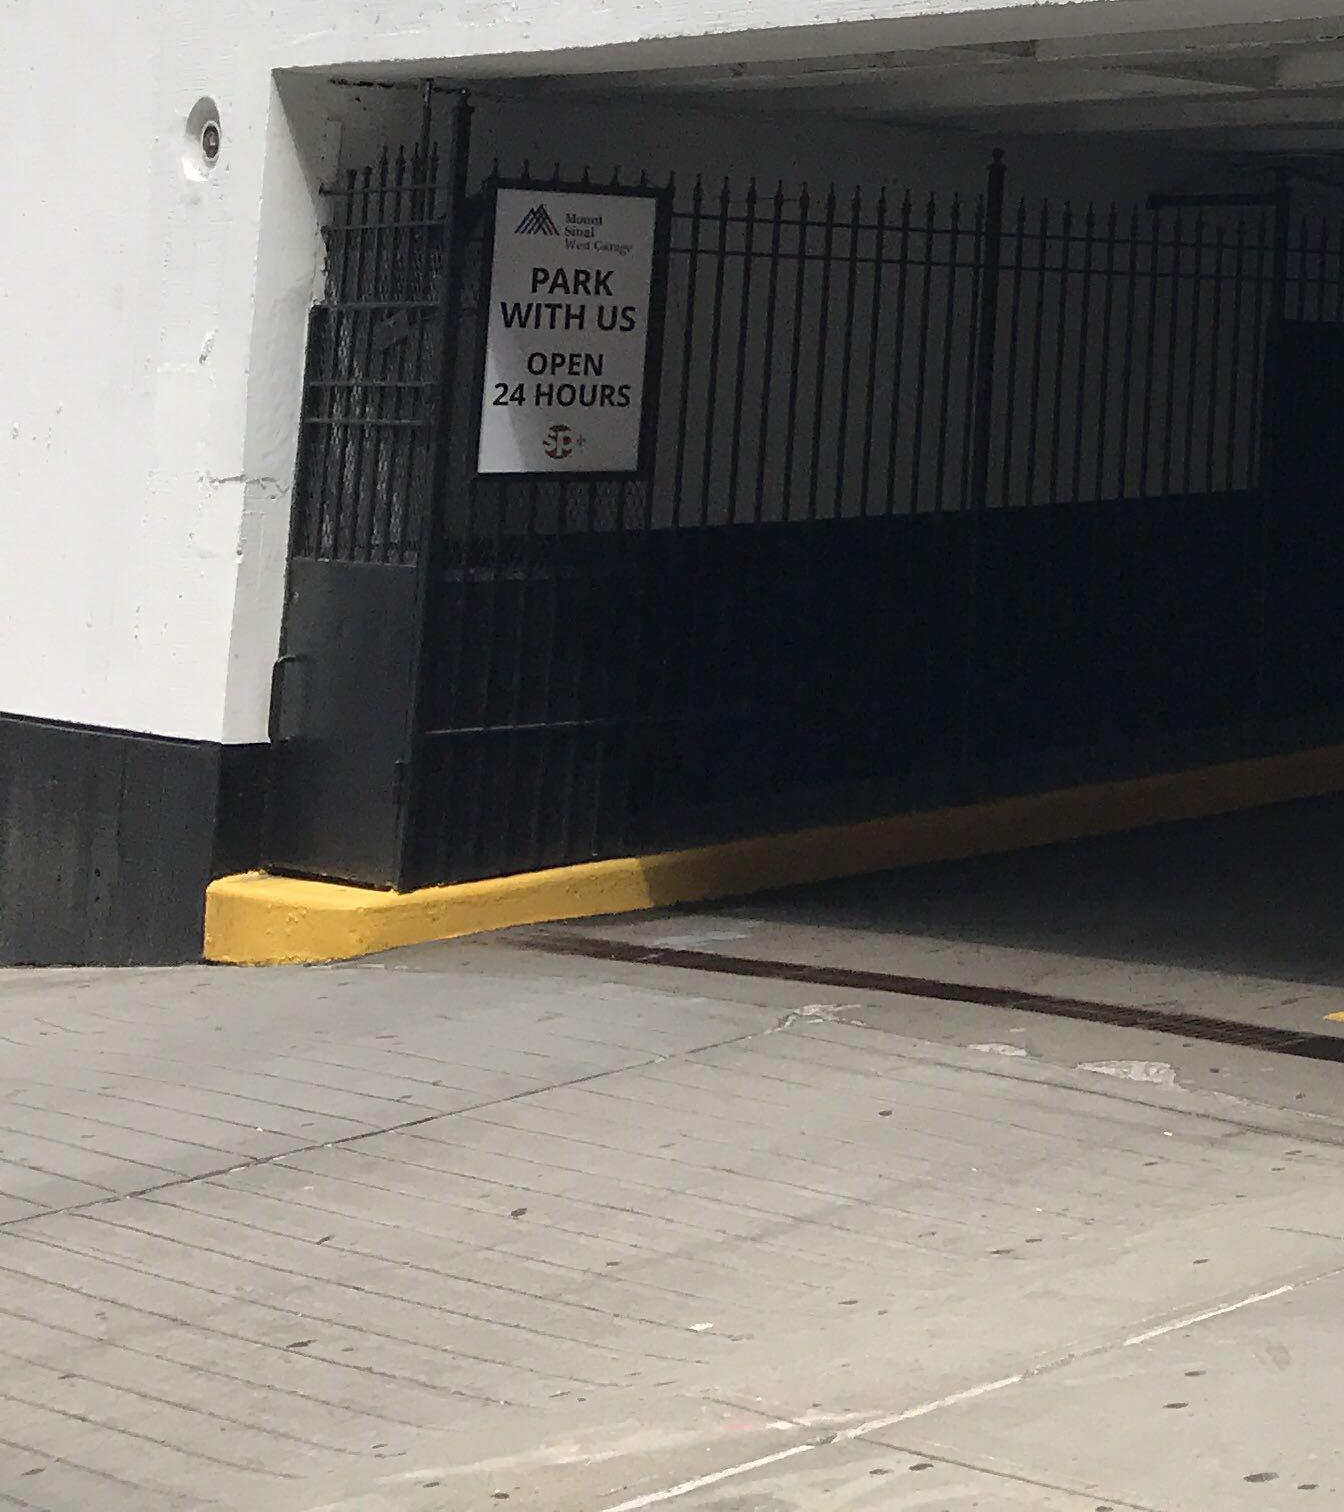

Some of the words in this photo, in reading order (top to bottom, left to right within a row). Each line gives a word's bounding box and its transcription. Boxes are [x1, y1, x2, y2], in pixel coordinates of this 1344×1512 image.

[564, 225, 595, 238] Sinai
[565, 213, 603, 226] Mount
[564, 238, 590, 250] West
[593, 240, 633, 256] Garage
[531, 267, 615, 296] PARK
[501, 301, 585, 330] WITH
[597, 305, 636, 332] US
[527, 352, 604, 376] OPEN
[492, 382, 526, 406] 24
[534, 383, 631, 408] HOURS
